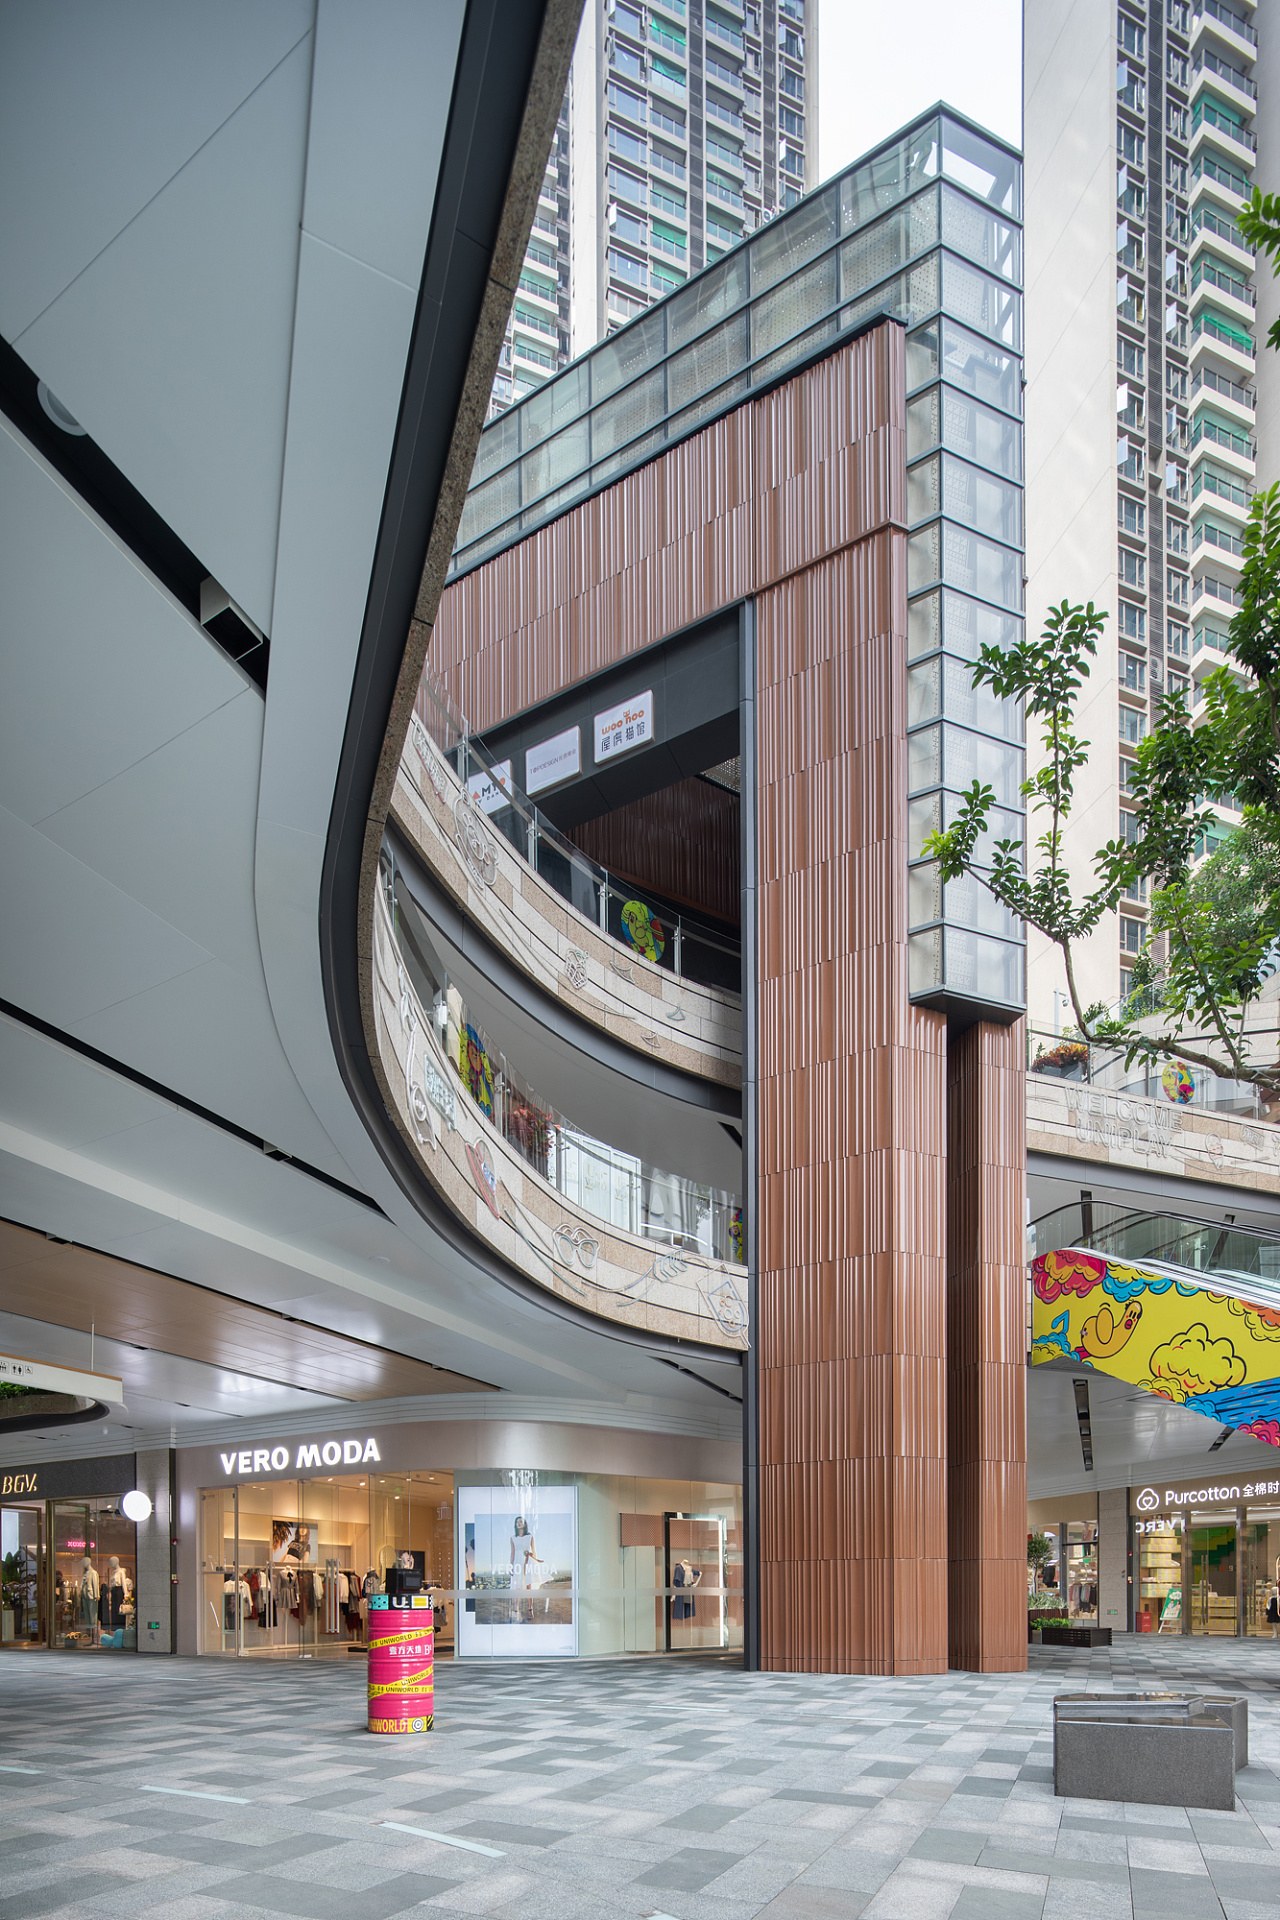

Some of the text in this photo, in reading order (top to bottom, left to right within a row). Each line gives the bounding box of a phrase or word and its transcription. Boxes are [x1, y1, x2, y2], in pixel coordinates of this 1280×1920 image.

[1065, 1087, 1183, 1134] WELCOME
[1076, 1118, 1172, 1158] UNIPLAY
[220, 1438, 381, 1475] VERO MODA
[1165, 1480, 1280, 1506] Purcotton 全棉时
[490, 1563, 558, 1575] VERO MODA
[379, 1633, 413, 1646] UNIWORLD
[389, 1645, 422, 1656] 壹方天地
[401, 1669, 430, 1686] UNIWORLD
